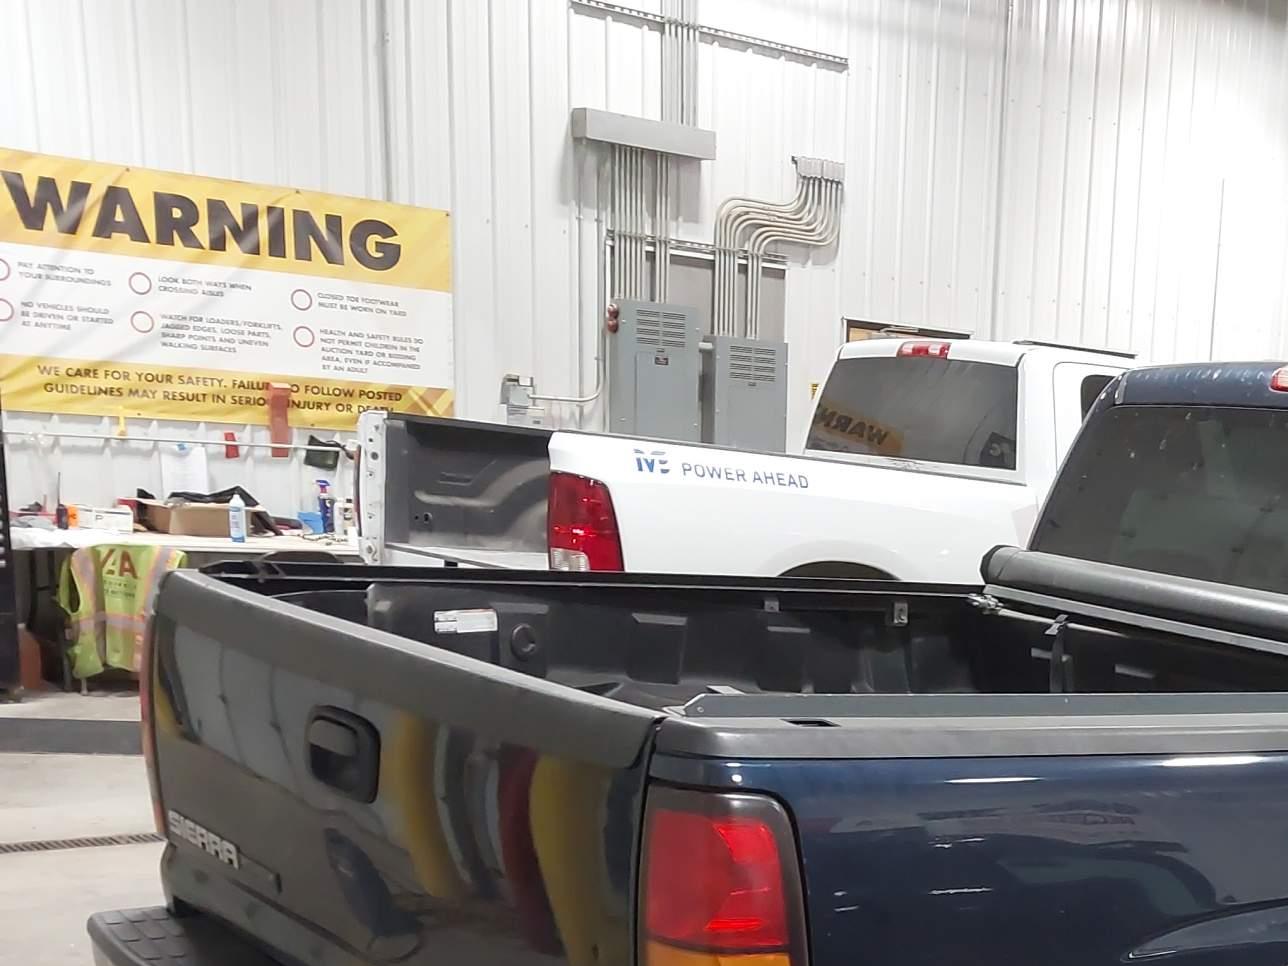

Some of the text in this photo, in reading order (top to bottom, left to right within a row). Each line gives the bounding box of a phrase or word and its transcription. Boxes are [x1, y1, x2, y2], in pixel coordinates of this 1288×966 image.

[1, 170, 401, 271] WARNING
[158, 275, 180, 284] LOOK
[37, 365, 61, 377] WE
[65, 367, 100, 379] CARE
[104, 369, 131, 382] FOR
[135, 372, 174, 385] YOUR
[178, 374, 228, 389] SAFETY.
[304, 384, 355, 398] FOLLOW
[358, 389, 403, 402] POSTED
[44, 382, 124, 397] GUIDELINES
[128, 388, 157, 400] MAY
[163, 390, 207, 403] RESULT
[211, 394, 226, 404] IN
[231, 396, 268, 406] SERIO
[287, 398, 330, 411] INJURY
[336, 403, 354, 413] OR
[681, 462, 809, 489] POWER AHEAD
[168, 809, 239, 870] SIERRA
